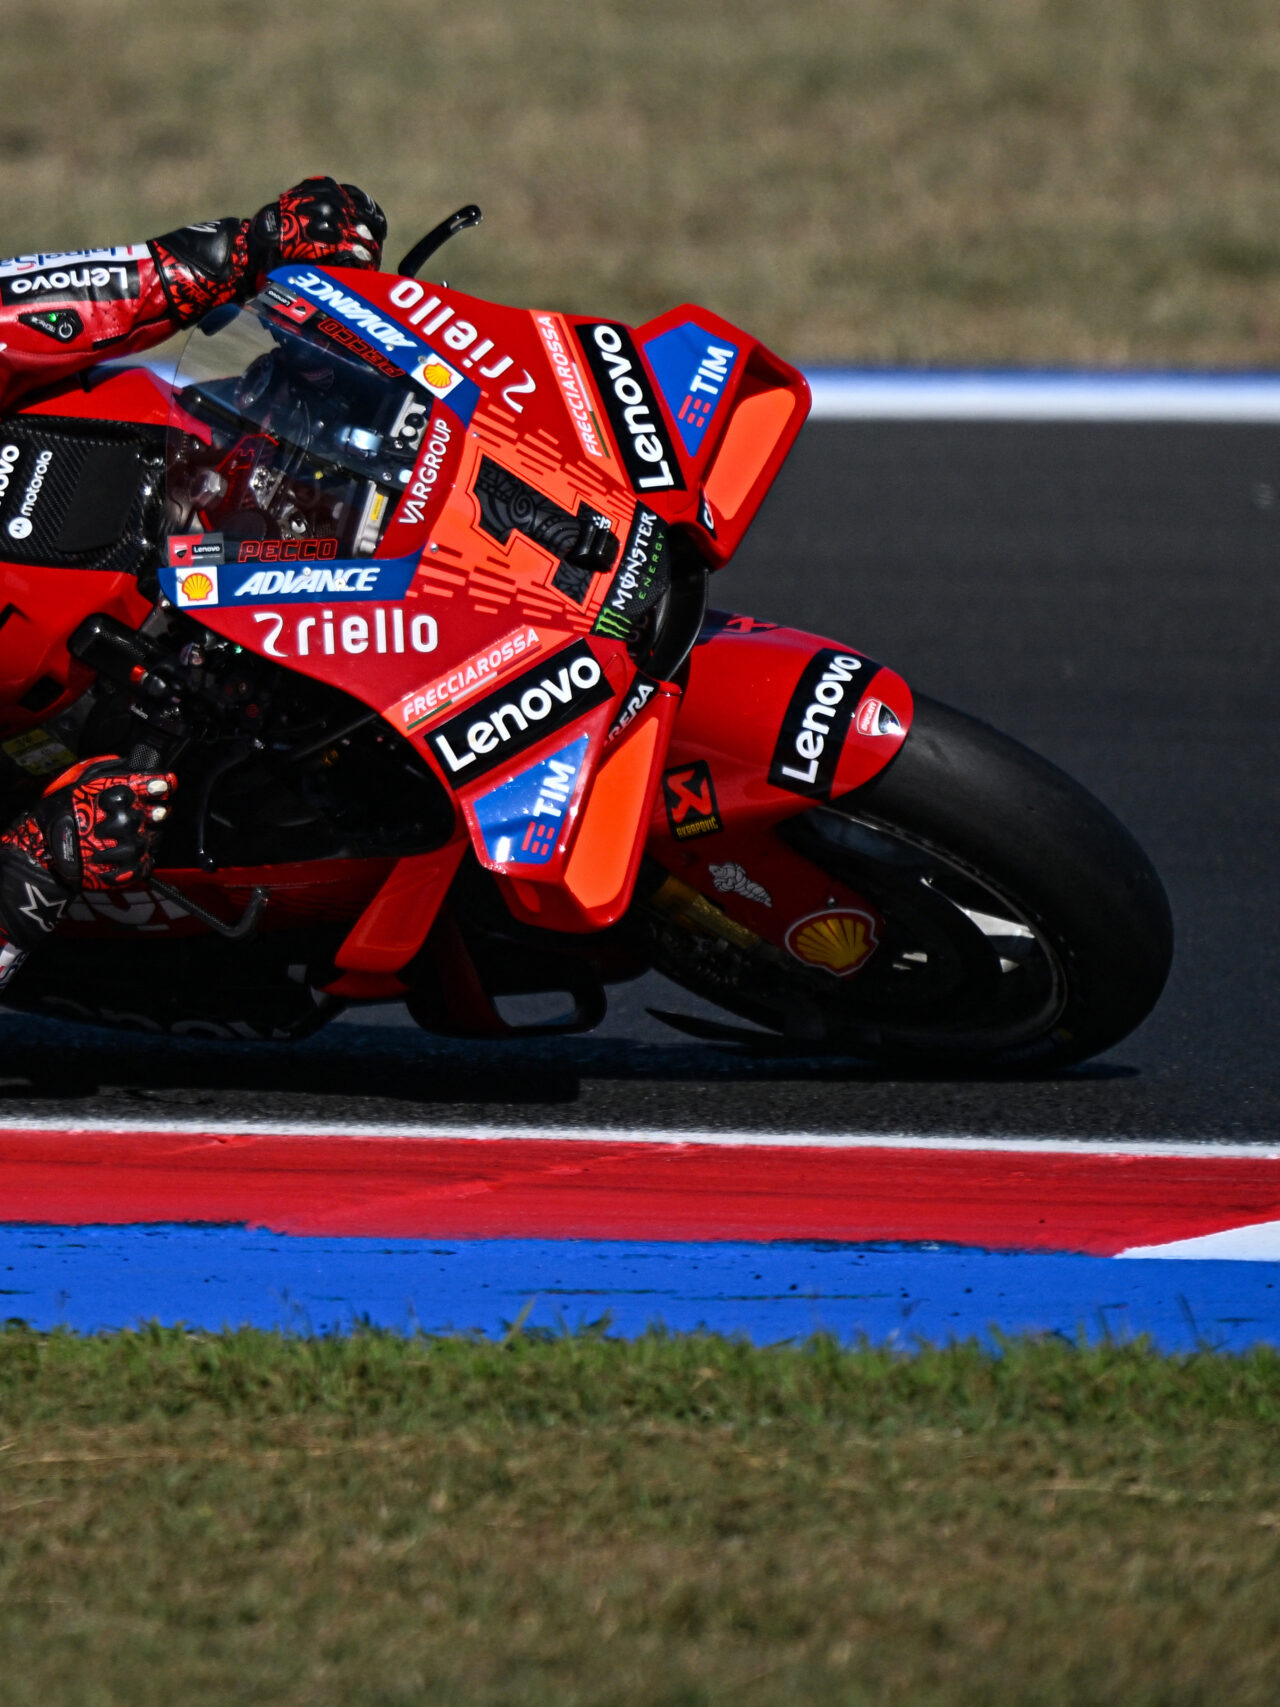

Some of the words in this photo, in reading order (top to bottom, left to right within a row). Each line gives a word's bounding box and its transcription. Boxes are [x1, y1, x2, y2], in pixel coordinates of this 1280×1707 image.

[10, 267, 128, 293] Lenovo
[297, 272, 418, 348] ADVANCE
[318, 317, 406, 378] PECCO
[389, 279, 513, 379] riello
[536, 315, 602, 458] FRECCIAROSSA
[689, 345, 734, 395] TIM
[593, 325, 674, 489] Lenovo
[20, 450, 54, 518] motorola
[192, 544, 221, 555] Lenovo
[234, 567, 381, 597] ADVANCE
[237, 538, 338, 563] PECCO
[611, 511, 658, 611] MONSTER
[638, 532, 665, 600] ENERGY
[299, 608, 440, 655] riello
[402, 629, 540, 724] FRECCIAROSSA
[435, 655, 602, 773] Lenovo
[781, 653, 863, 785] Lenovo
[531, 759, 577, 819] TIM
